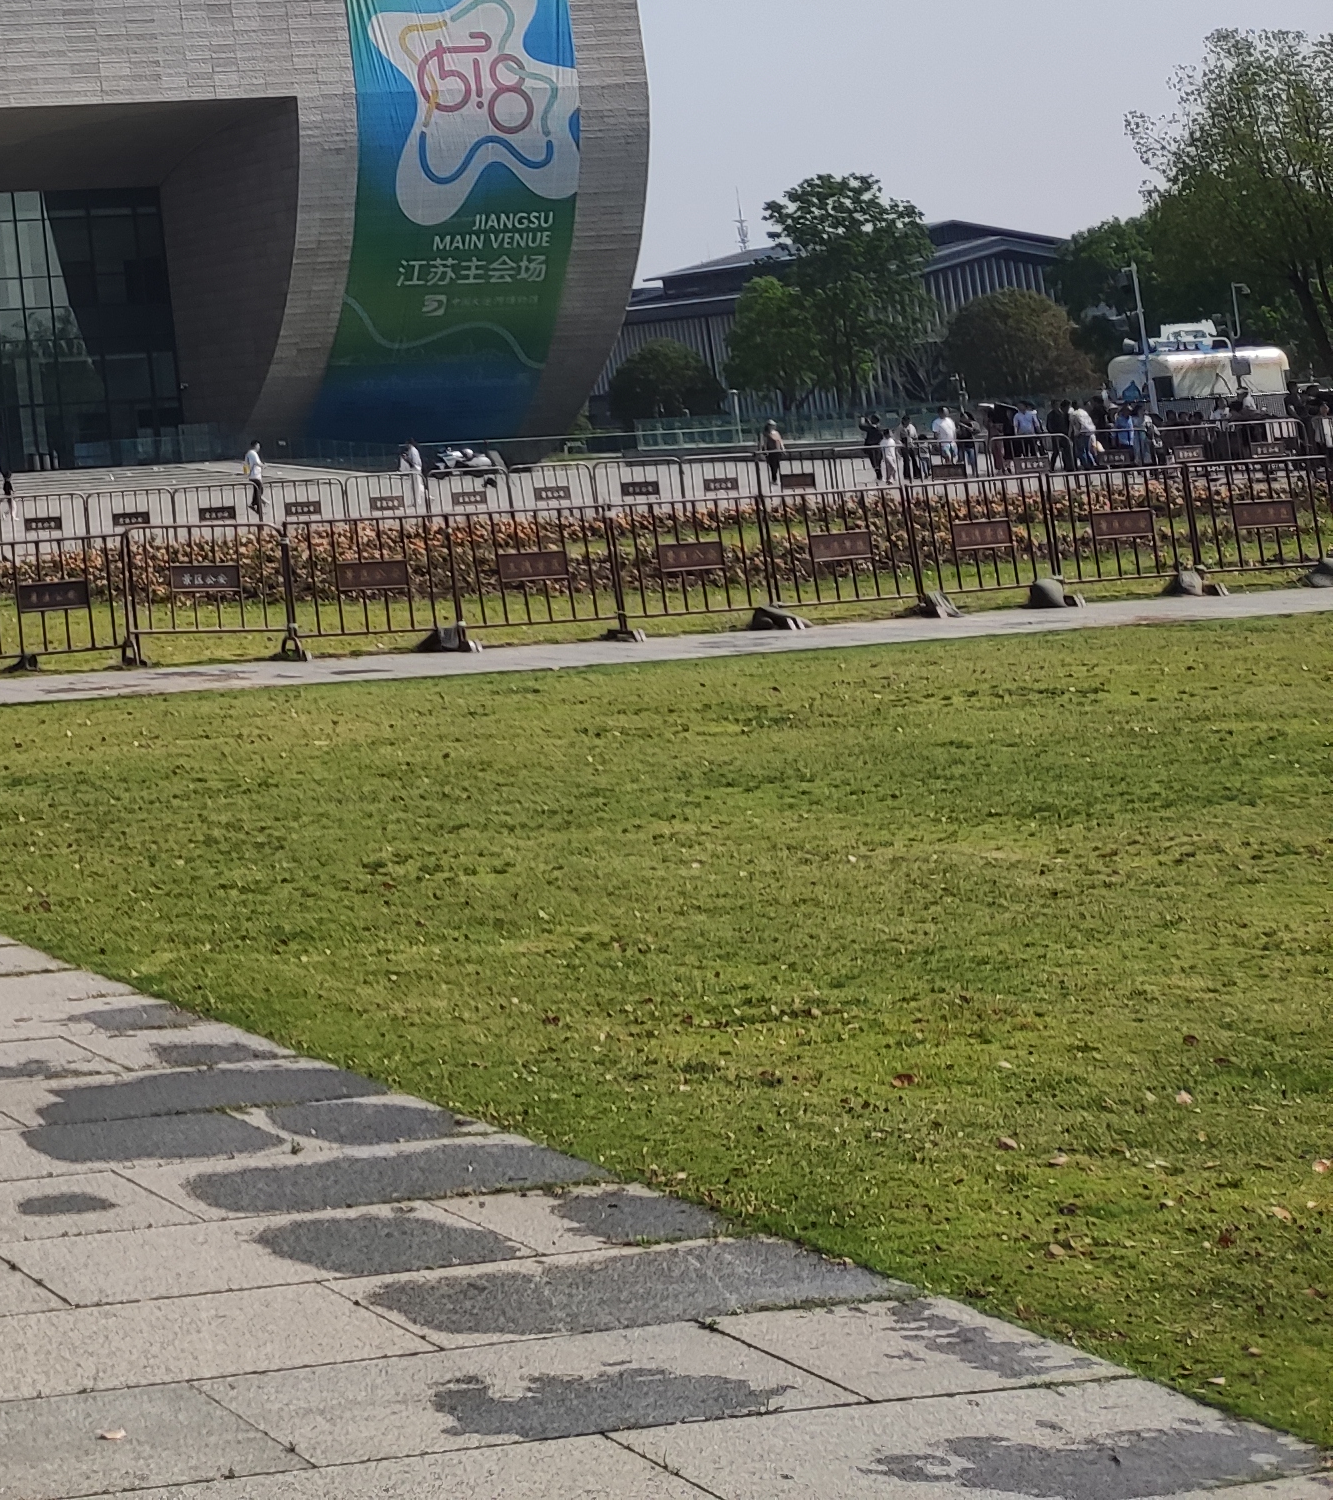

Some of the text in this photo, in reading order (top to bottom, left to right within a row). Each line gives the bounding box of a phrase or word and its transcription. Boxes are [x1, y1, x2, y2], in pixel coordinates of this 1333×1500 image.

[472, 211, 554, 231] JIANGSU
[433, 231, 552, 252] MAIN VENUE
[396, 254, 547, 287] 江苏主会场
[182, 572, 227, 586] 景区公安
